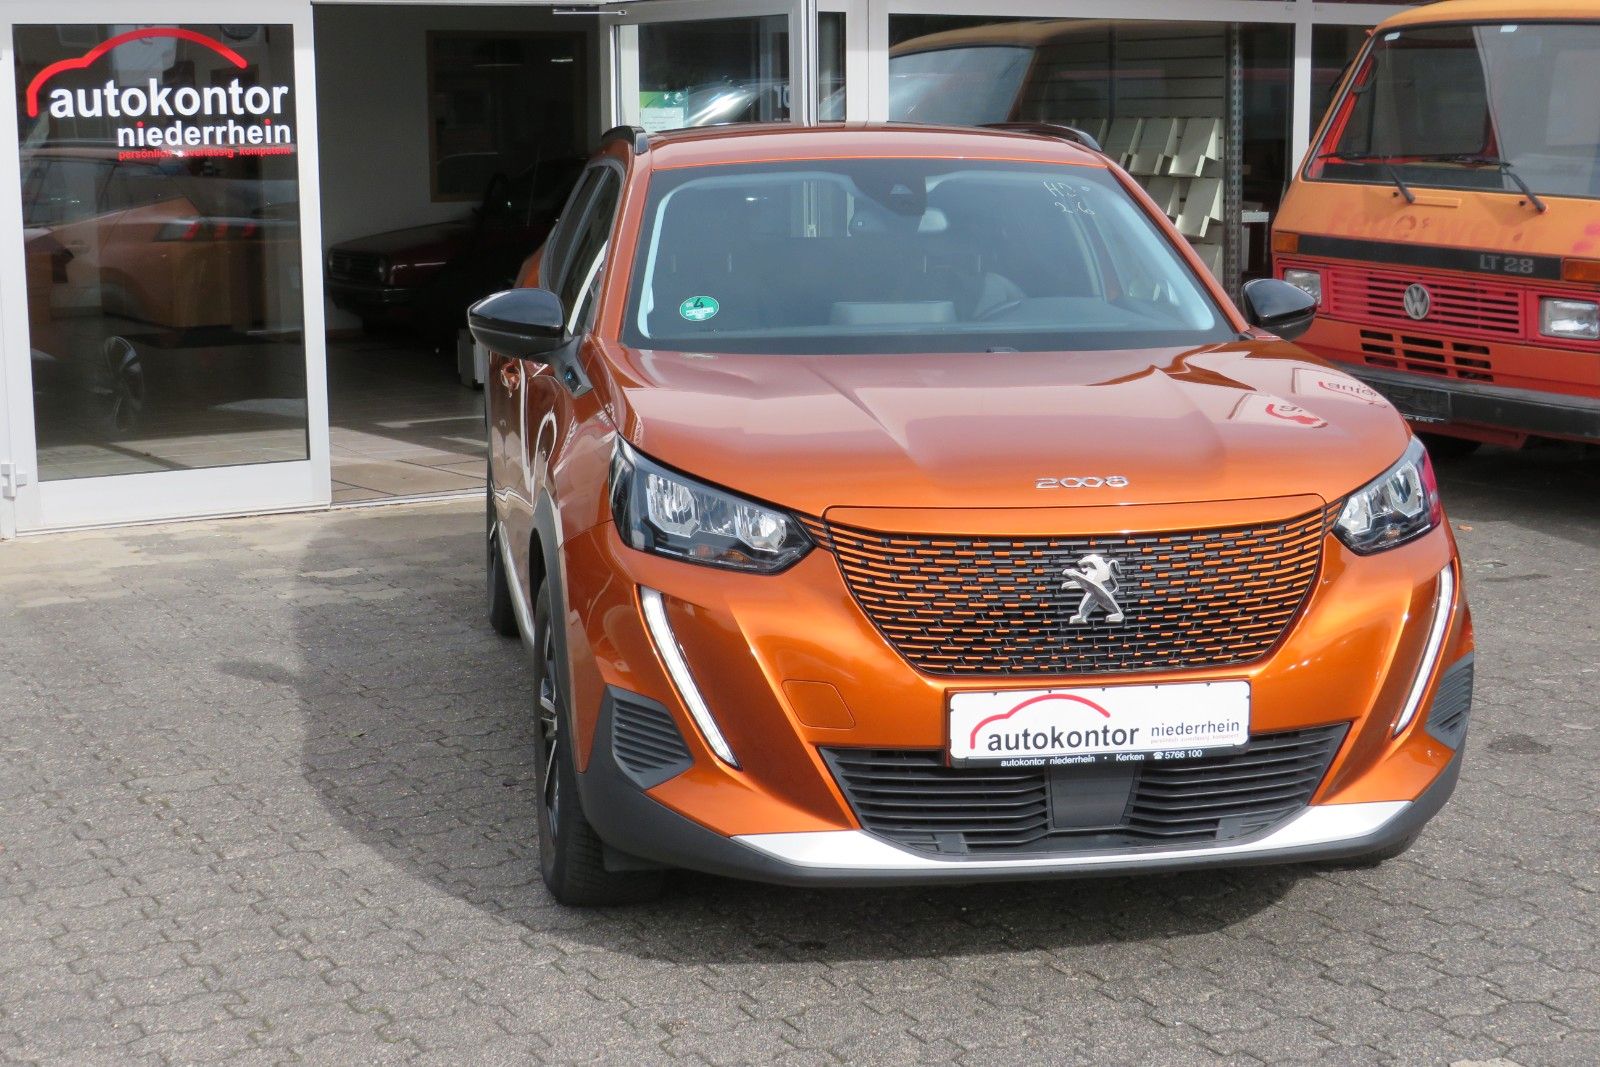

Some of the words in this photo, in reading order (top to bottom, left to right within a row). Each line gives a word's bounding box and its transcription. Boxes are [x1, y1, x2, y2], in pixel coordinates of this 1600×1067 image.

[50, 78, 288, 118] autokontor
[117, 119, 290, 147] niederrhein
[1480, 254, 1500, 270] LT
[1504, 257, 1533, 273] 28
[1035, 475, 1128, 489] 2008
[988, 725, 1139, 752] autokontor
[1151, 719, 1240, 737] niederrhein
[1001, 757, 1045, 767] autokontor
[1050, 754, 1095, 765] niederrhein
[1115, 752, 1145, 762] Kerken
[1165, 750, 1186, 760] 5766
[1188, 749, 1203, 758] 100
